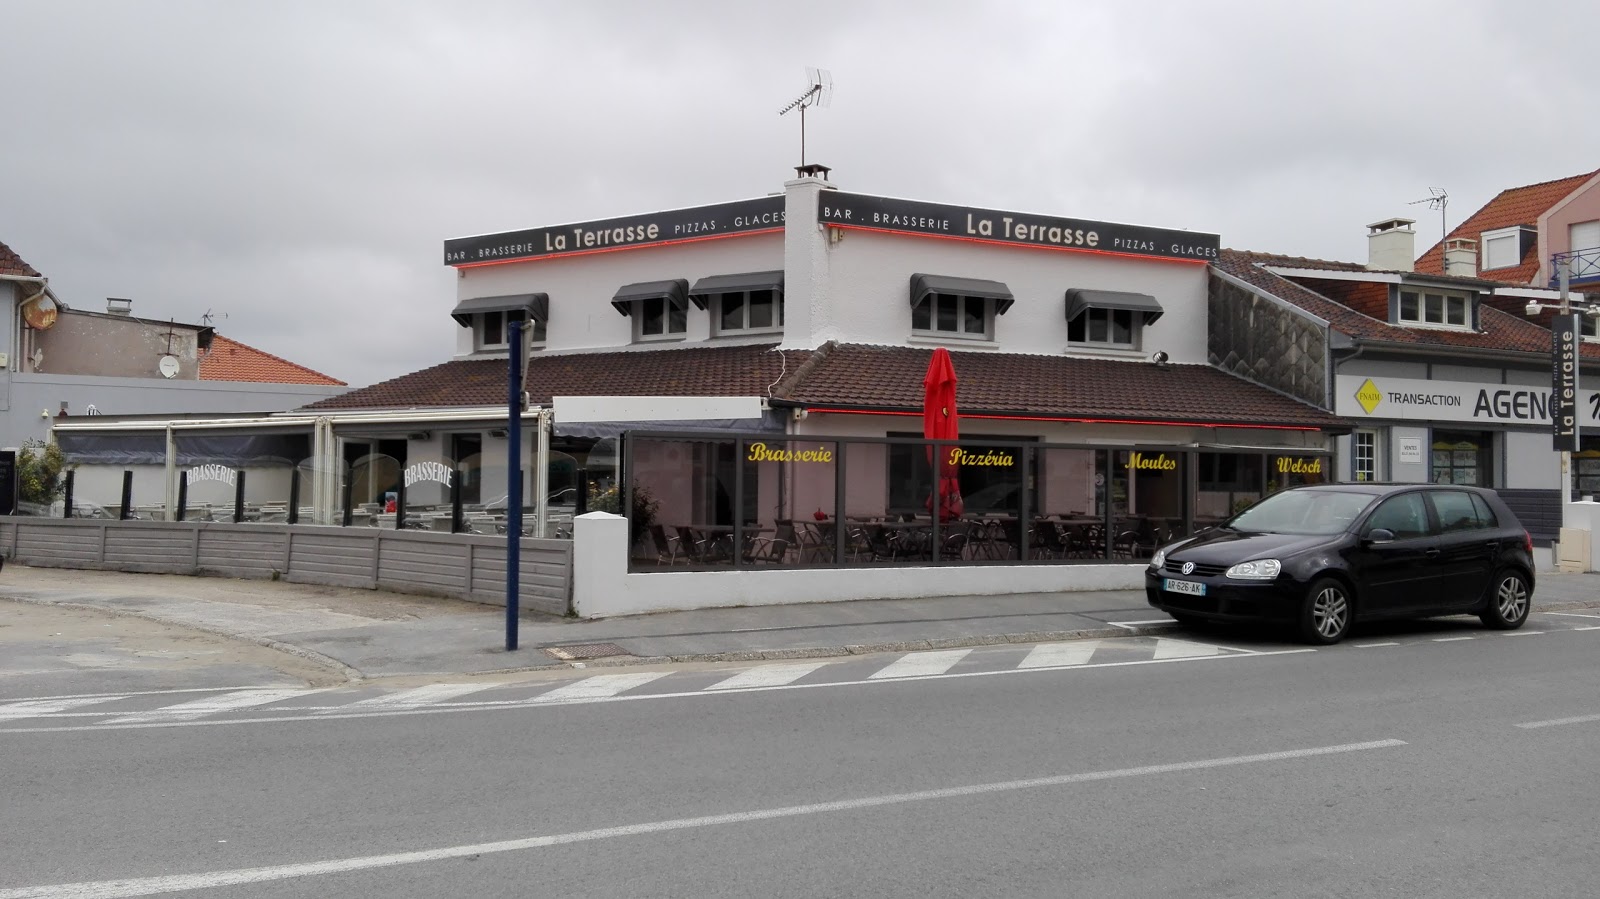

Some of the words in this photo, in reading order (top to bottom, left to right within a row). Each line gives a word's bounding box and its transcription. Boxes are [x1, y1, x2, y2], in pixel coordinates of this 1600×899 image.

[447, 251, 466, 262] BAR
[479, 243, 533, 258] BRASSERIE
[545, 232, 566, 251] La
[574, 223, 660, 249] Terrasse
[675, 220, 716, 235] PIZZAS
[734, 211, 786, 227] GLACES
[824, 207, 852, 220] BAR
[873, 212, 949, 230] BRASSERIE
[967, 213, 992, 236] La
[1003, 217, 1099, 247] Terrasse
[1114, 238, 1155, 252] PIZZAS
[1172, 244, 1218, 258] GLACES
[1561, 331, 1574, 408] Terrasse
[1359, 392, 1380, 401] FNAIM
[1388, 392, 1461, 407] TRANSACTION
[1473, 388, 1554, 420] AGEN
[1561, 415, 1574, 436] La
[748, 442, 833, 463] Brasserie
[949, 447, 1014, 467] Pizzéria
[1124, 452, 1176, 470] Moules
[186, 463, 236, 487] BRASSERIE
[404, 461, 454, 488] BRASSERIE
[1277, 457, 1321, 474] Welsch
